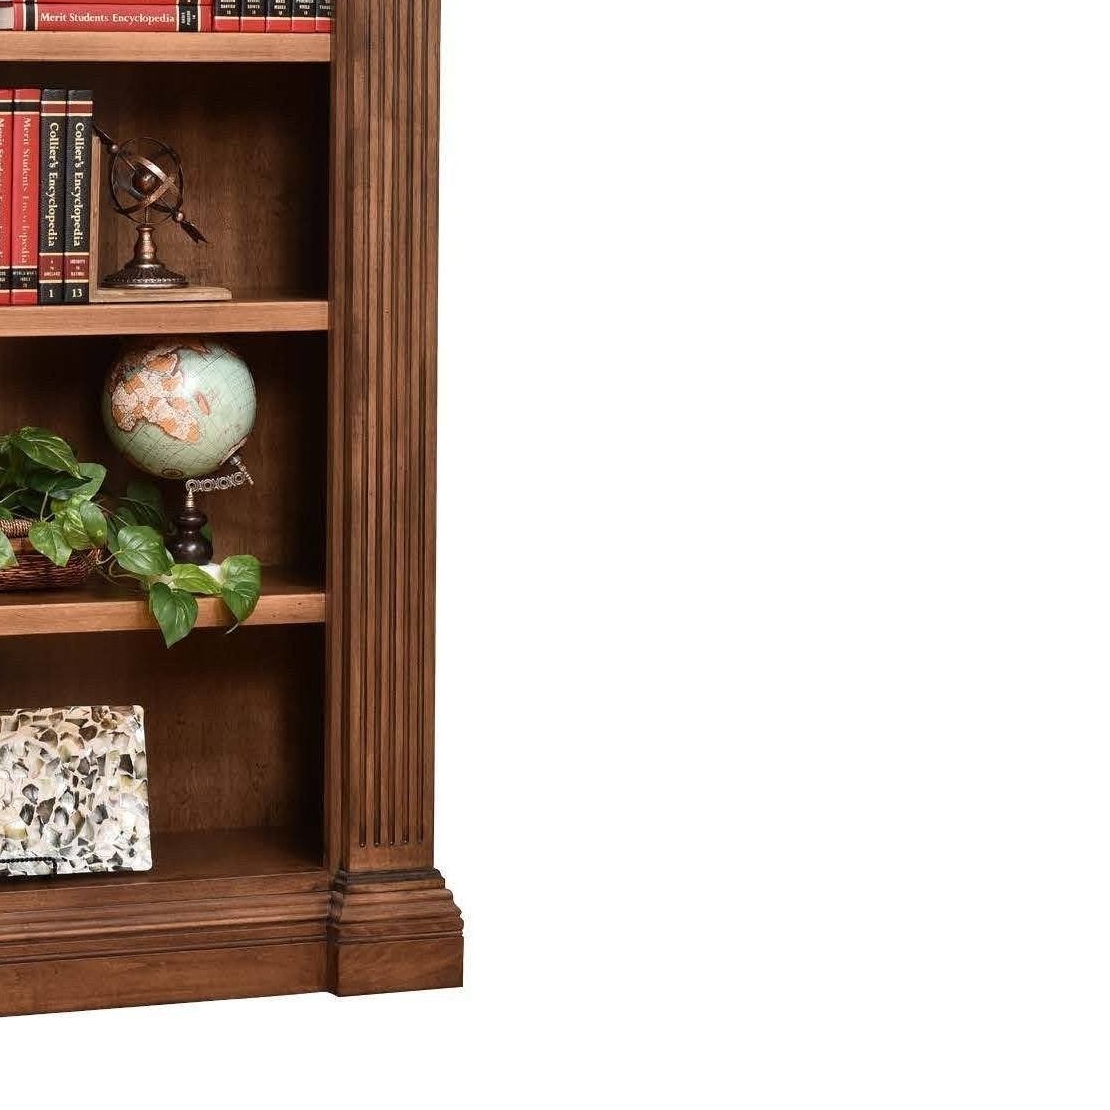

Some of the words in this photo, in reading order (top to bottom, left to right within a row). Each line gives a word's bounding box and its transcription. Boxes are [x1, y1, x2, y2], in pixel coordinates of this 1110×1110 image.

[39, 13, 67, 23] Merit
[68, 13, 109, 23] Students
[112, 13, 176, 26] Encyclopedia
[22, 117, 32, 148] Merit
[49, 121, 59, 168] Collier's
[74, 121, 85, 168] Collier's
[21, 148, 31, 193] Students
[45, 171, 58, 248] Encyclopedia
[70, 171, 84, 248] Encyclopedia
[49, 289, 54, 298] 1
[72, 288, 83, 298] 13
